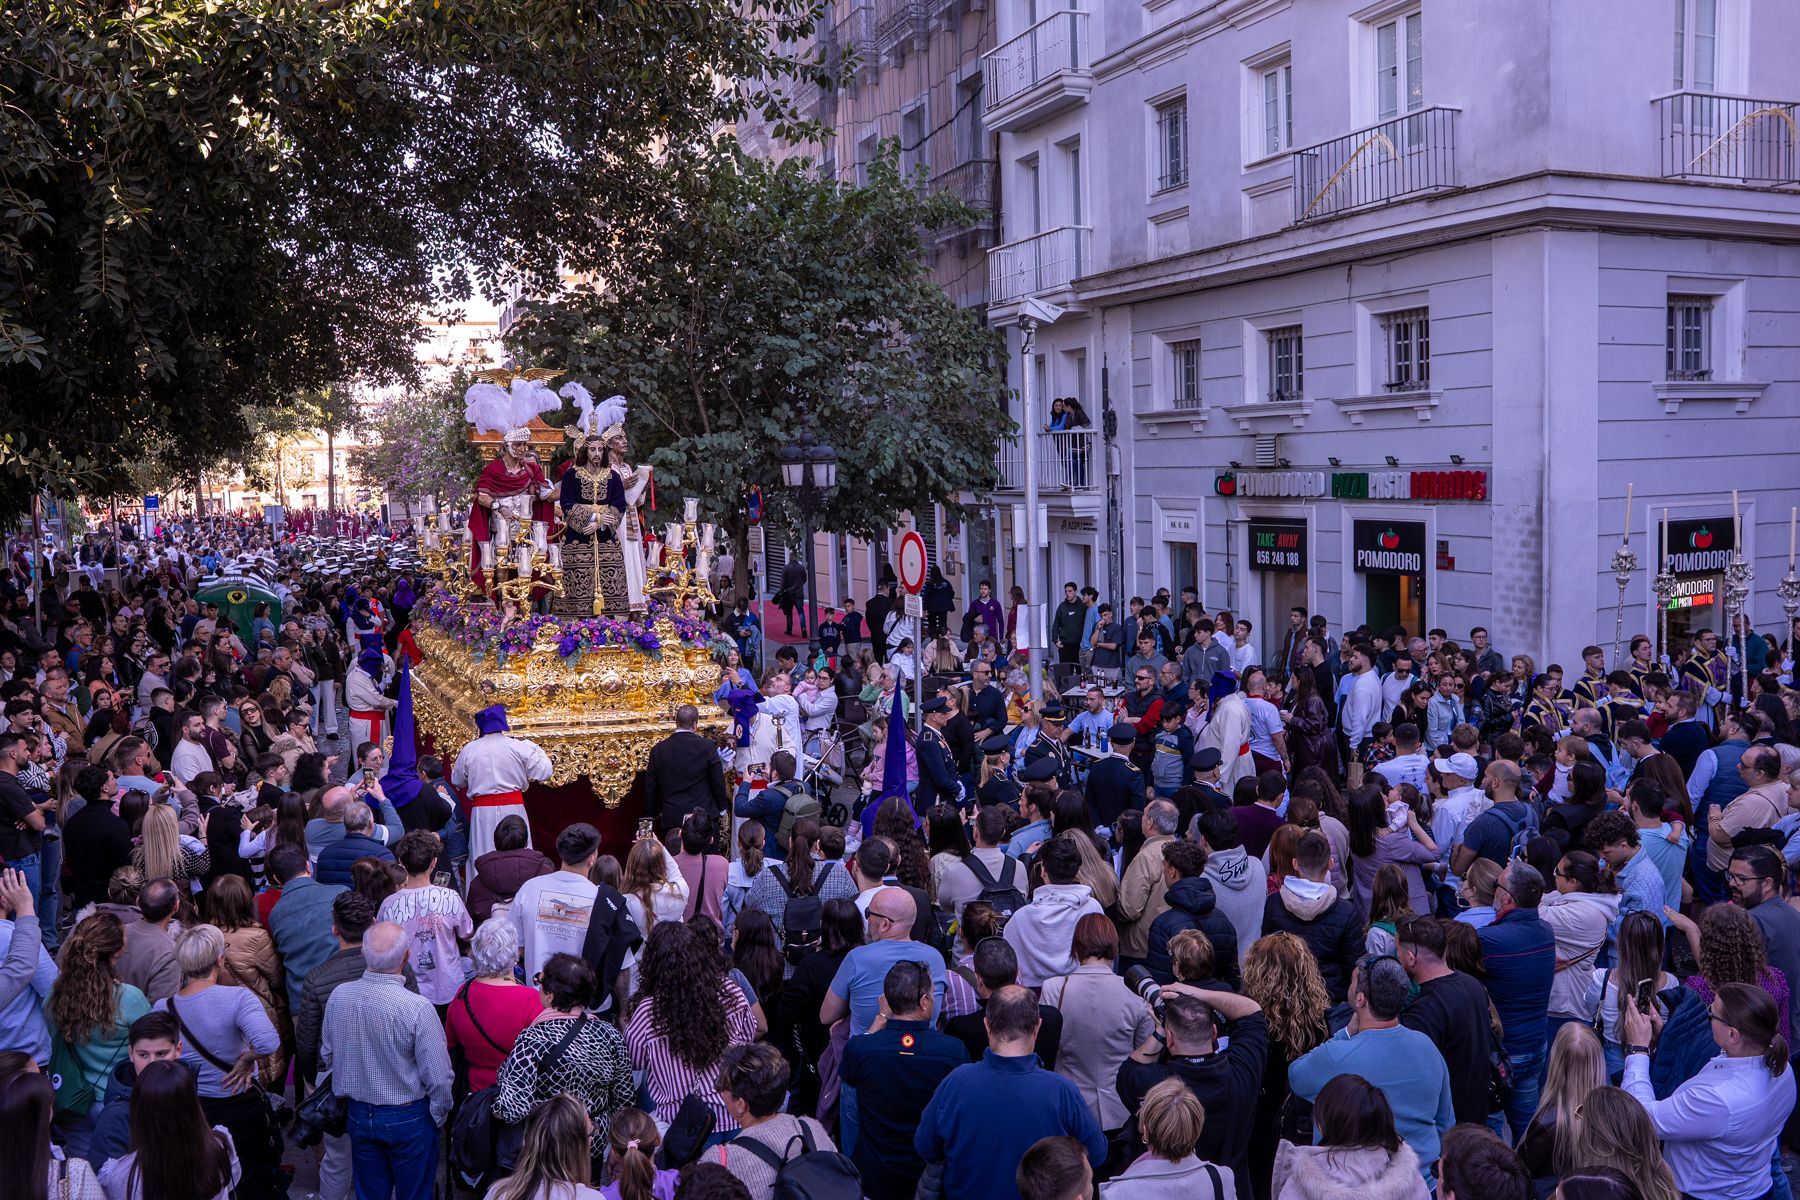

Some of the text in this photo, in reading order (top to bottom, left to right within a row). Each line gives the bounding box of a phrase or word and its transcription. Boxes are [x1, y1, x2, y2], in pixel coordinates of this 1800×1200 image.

[1237, 472, 1325, 497] POMODORO
[1369, 471, 1411, 499] PASTA
[1257, 532, 1299, 548] TAKE AWAY
[1257, 550, 1299, 566] 856 248 188
[1358, 550, 1420, 571] POMODORO
[1666, 549, 1733, 573] POMODORO
[1669, 579, 1714, 597] OMODORO
[417, 887, 460, 917] YORK
